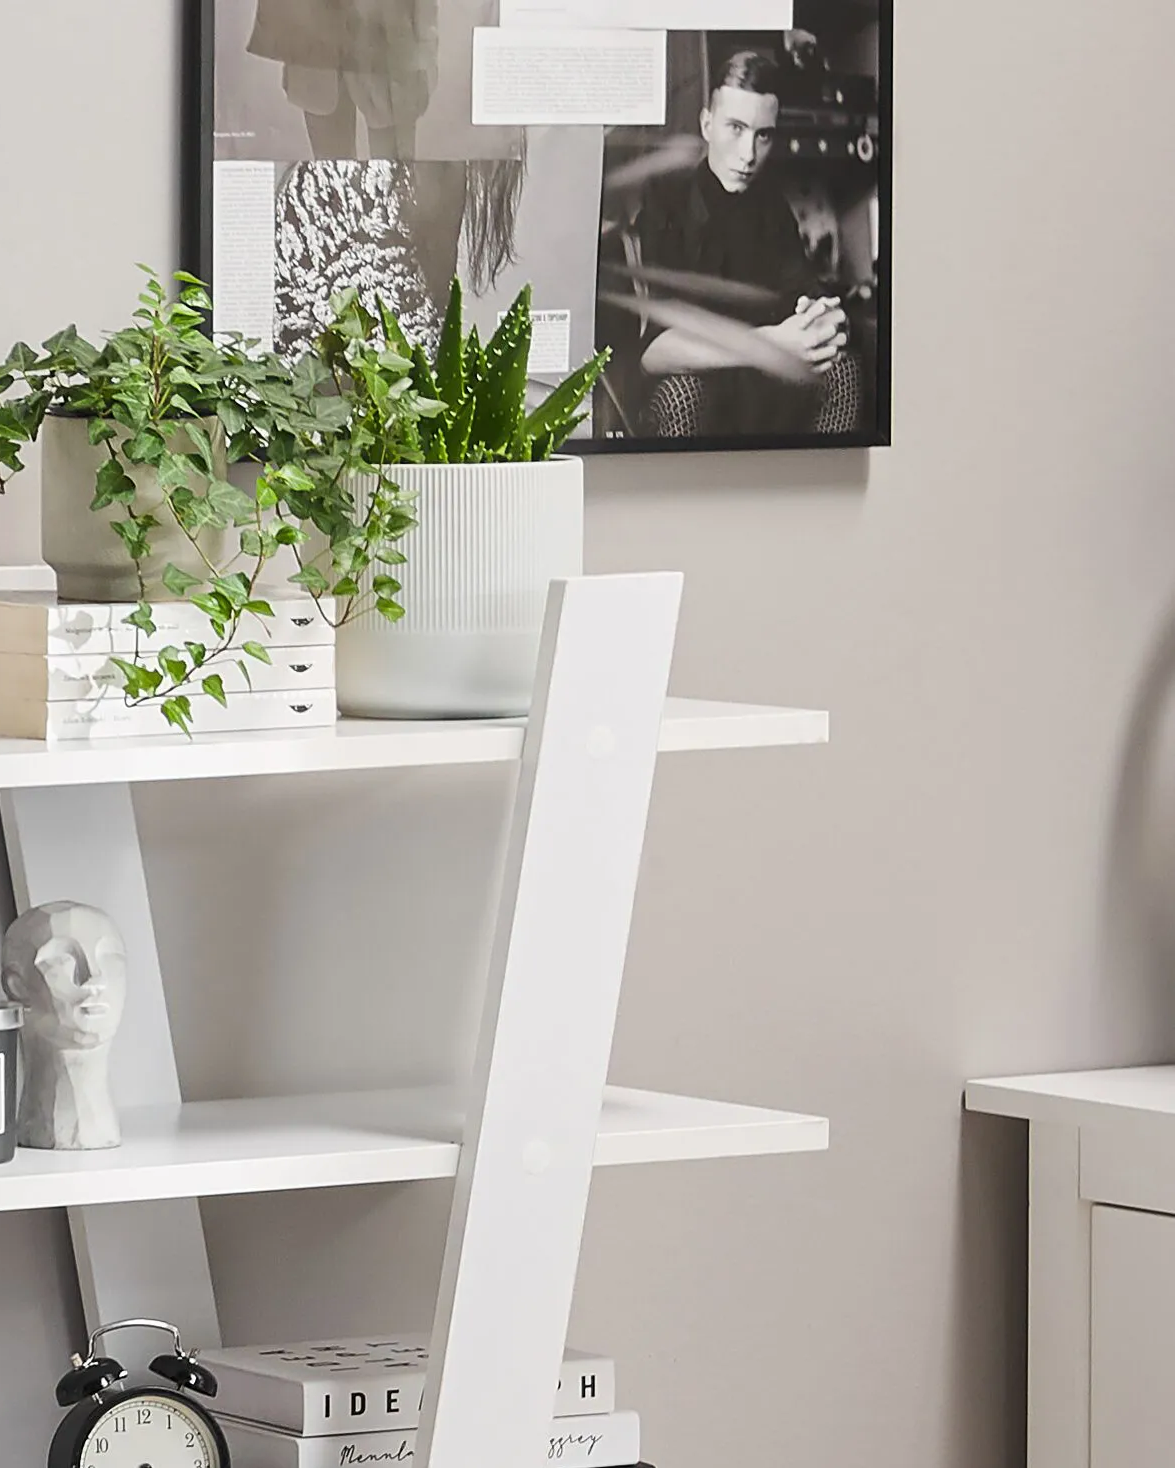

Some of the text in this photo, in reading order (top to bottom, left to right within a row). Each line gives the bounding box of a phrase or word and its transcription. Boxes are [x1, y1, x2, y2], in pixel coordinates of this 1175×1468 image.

[324, 1387, 425, 1418] IDE
[114, 1416, 126, 1432] 11
[136, 1408, 152, 1425] 12
[95, 1437, 109, 1454] 10
[185, 1432, 195, 1448] 2
